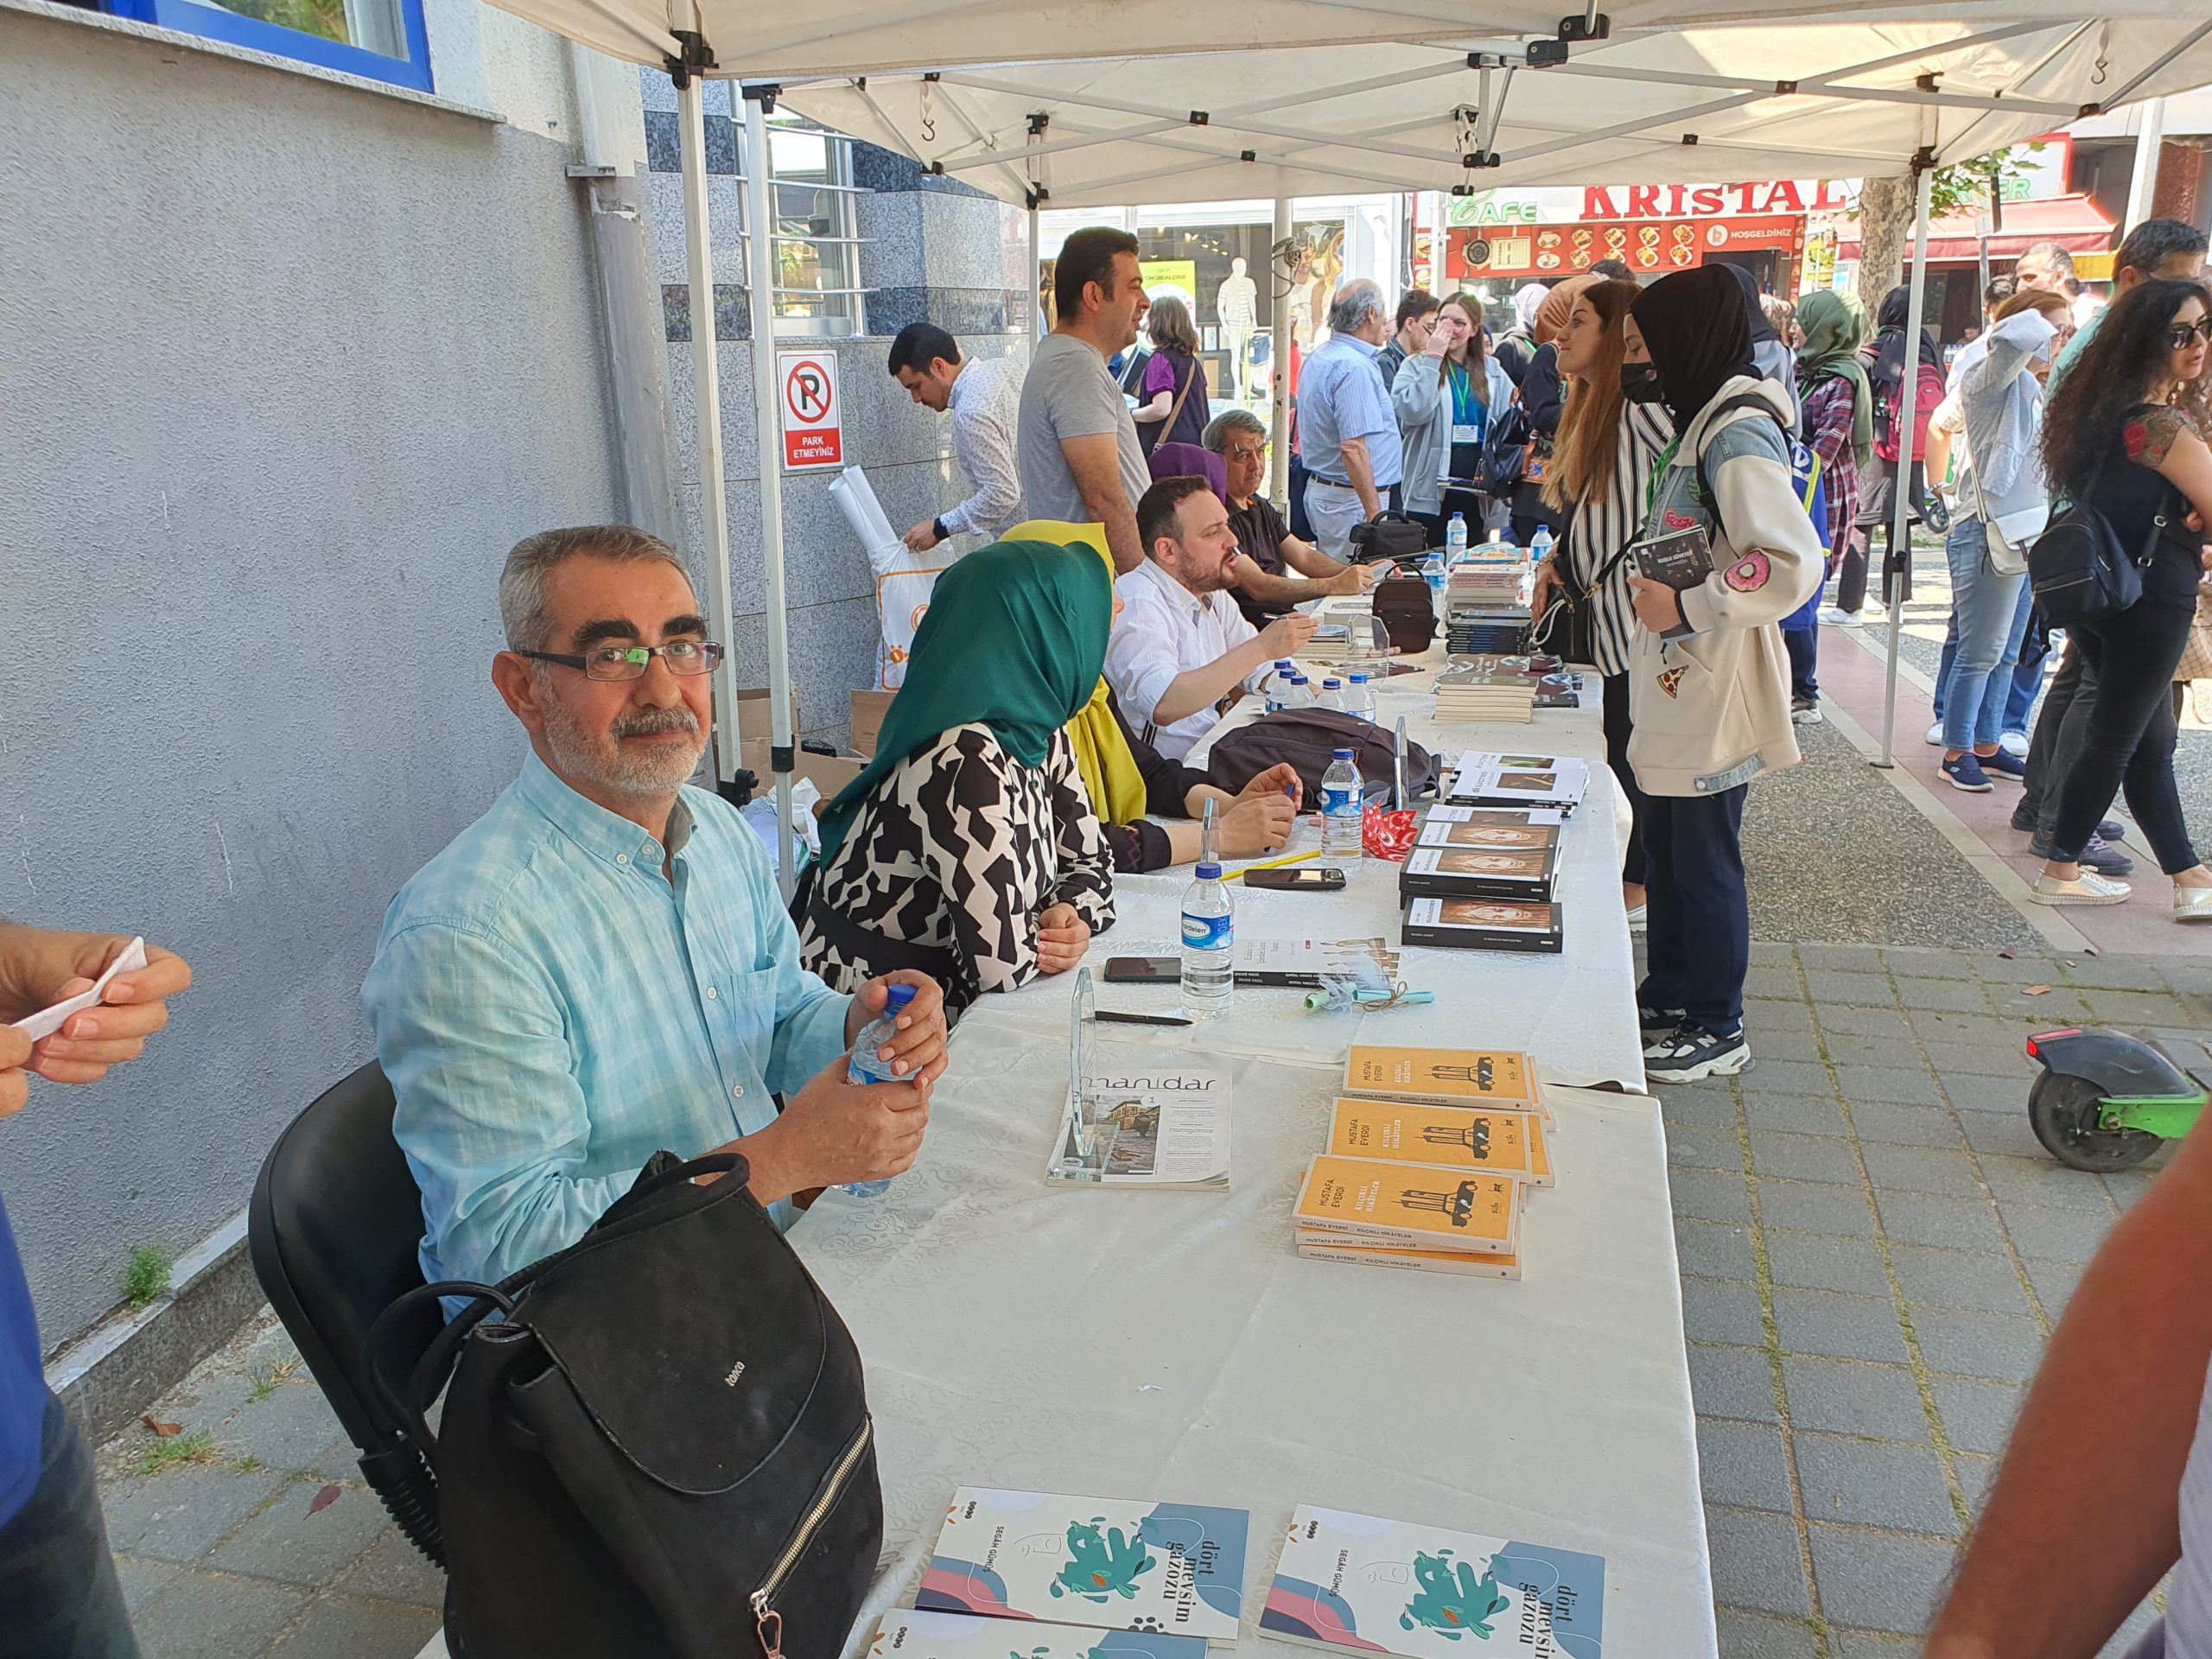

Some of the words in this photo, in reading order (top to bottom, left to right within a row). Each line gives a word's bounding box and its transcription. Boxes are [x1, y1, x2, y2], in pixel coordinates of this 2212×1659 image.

[1448, 188, 1537, 225] CAFE
[1731, 228, 1792, 239] HOŞGELDİNİZ
[793, 446, 835, 459] ETMEYİNİZ
[802, 435, 824, 446] PARK
[1348, 1119, 1358, 1145] MUSTAFA
[1319, 1179, 1334, 1206] MUSTAFA
[1162, 1541, 1186, 1599] gazozu
[1198, 1541, 1221, 1576] dört
[1175, 1556, 1197, 1623] mevsim
[1555, 1585, 1578, 1623] dört
[1519, 1582, 1541, 1644] gazozu
